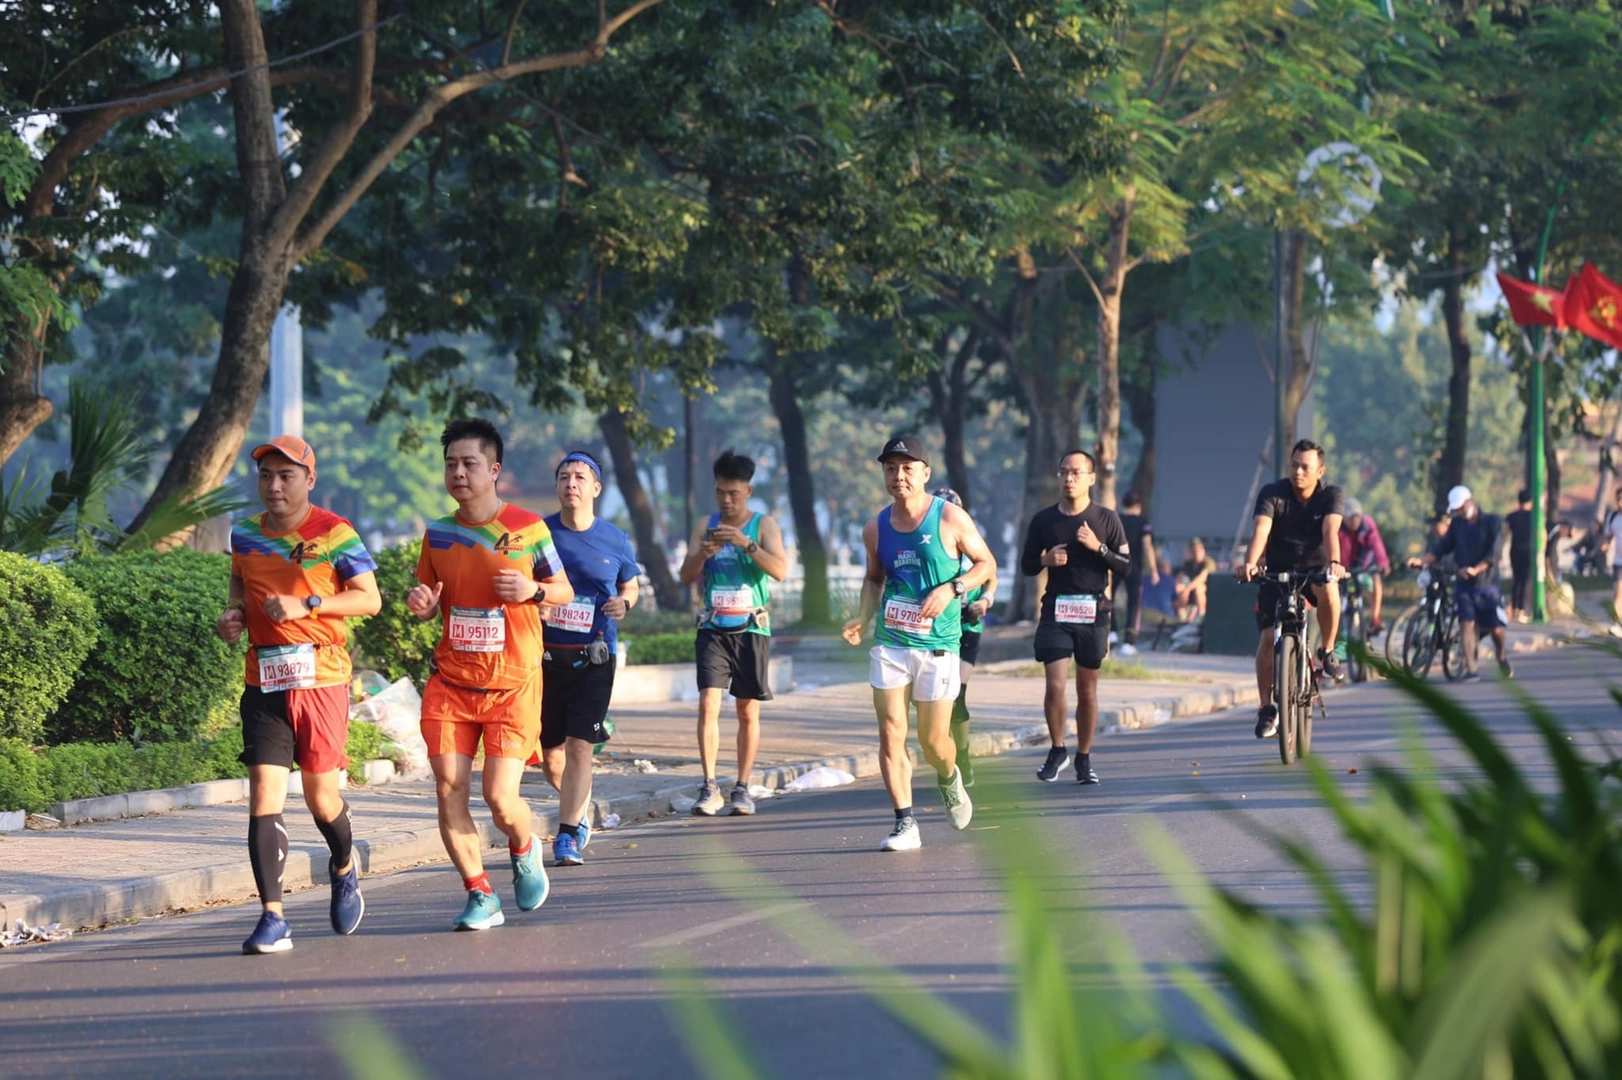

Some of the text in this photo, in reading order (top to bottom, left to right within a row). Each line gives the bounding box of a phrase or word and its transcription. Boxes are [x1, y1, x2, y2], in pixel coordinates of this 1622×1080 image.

[562, 608, 591, 622] 98247
[887, 606, 899, 620] M
[1070, 604, 1094, 615] 98520
[453, 624, 499, 639] M 95112
[264, 662, 310, 680] M 93879
